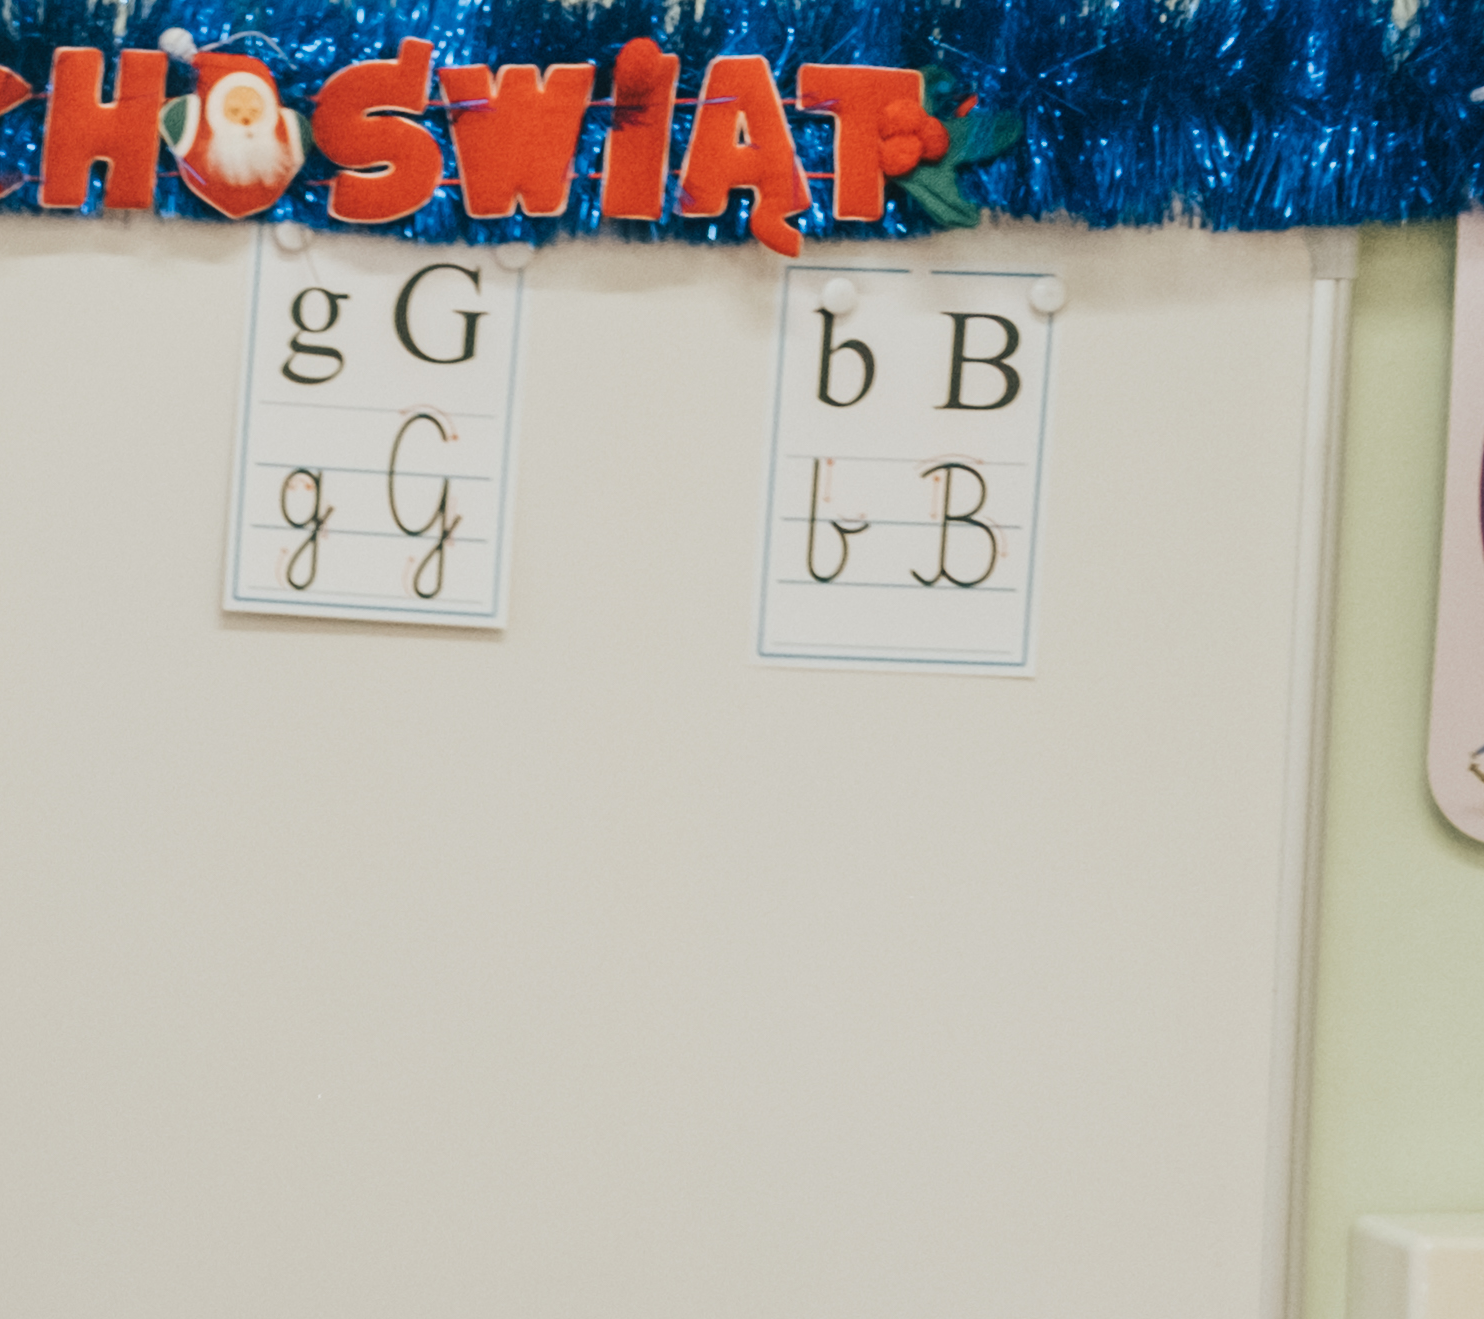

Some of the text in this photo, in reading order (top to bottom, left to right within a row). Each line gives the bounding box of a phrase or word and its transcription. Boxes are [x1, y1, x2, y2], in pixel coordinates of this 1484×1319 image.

[281, 262, 489, 386] g G
[814, 306, 1022, 411] b B
[280, 467, 335, 591] g
[910, 461, 998, 588] B
